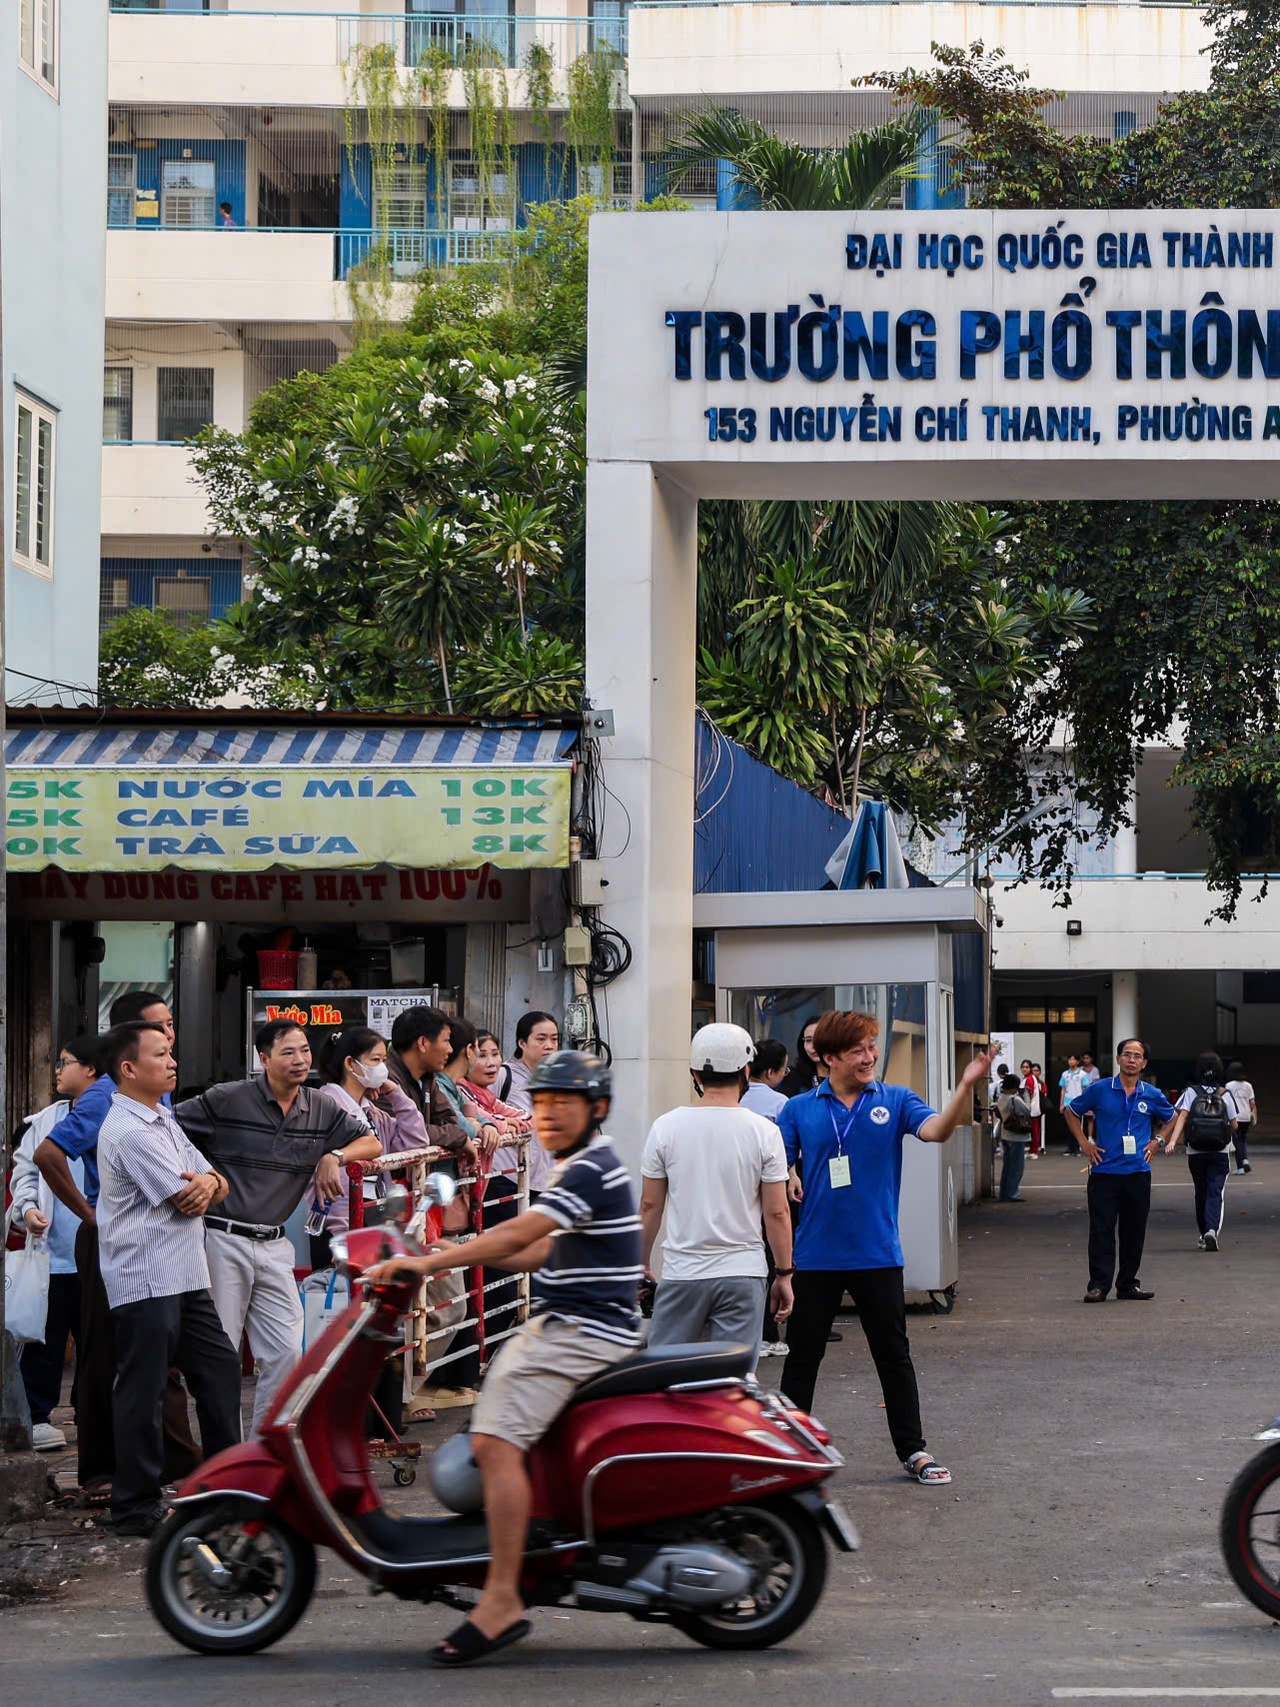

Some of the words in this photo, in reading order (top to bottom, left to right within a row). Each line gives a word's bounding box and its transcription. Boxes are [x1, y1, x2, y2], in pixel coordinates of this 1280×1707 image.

[846, 233, 901, 277] ĐẠI
[918, 233, 984, 277] HỌC
[997, 220, 1084, 274] QUỐC
[1097, 232, 1151, 268] GIA
[1162, 224, 1273, 268] THÀNH
[664, 293, 937, 382] TRƯỜNG
[959, 276, 1097, 381] PHỔ
[704, 406, 756, 442] 153
[769, 393, 900, 442] NGUYỄN
[914, 398, 968, 442] CHÍ
[982, 406, 1100, 445] THANH,
[1118, 397, 1253, 441] PHƯỜNG
[118, 776, 282, 799] NƯỚC
[302, 776, 417, 798] MÍA
[440, 778, 549, 798] 10K
[116, 804, 249, 827] CAFÉ
[440, 806, 549, 825] 13K
[115, 832, 226, 855] TRÀ
[243, 833, 360, 855] SỮA
[471, 834, 549, 854] 8K
[370, 998, 428, 1006] MATCHA
[310, 1004, 343, 1025] Mía
